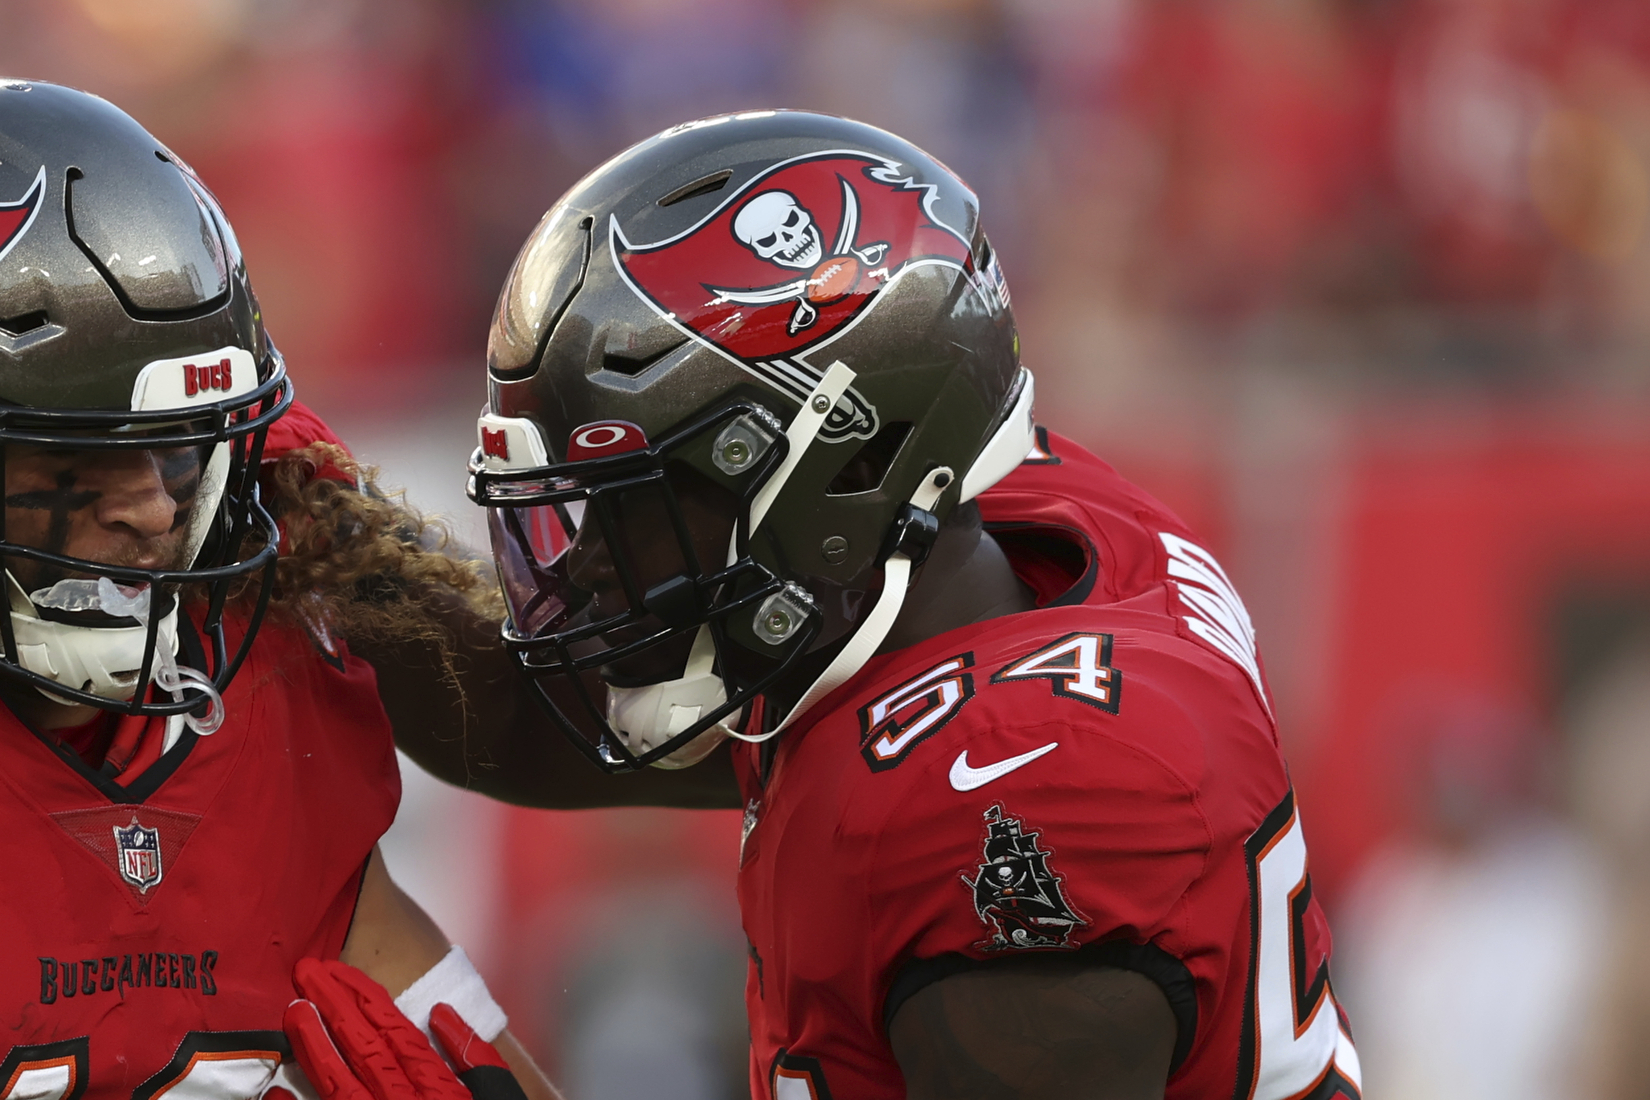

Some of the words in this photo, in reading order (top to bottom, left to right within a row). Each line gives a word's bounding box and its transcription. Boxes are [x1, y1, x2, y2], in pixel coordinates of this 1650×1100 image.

[182, 358, 233, 398] BUCS
[856, 631, 1122, 774] 54
[126, 850, 157, 879] NFL
[37, 949, 219, 1005] BUCCANEERS
